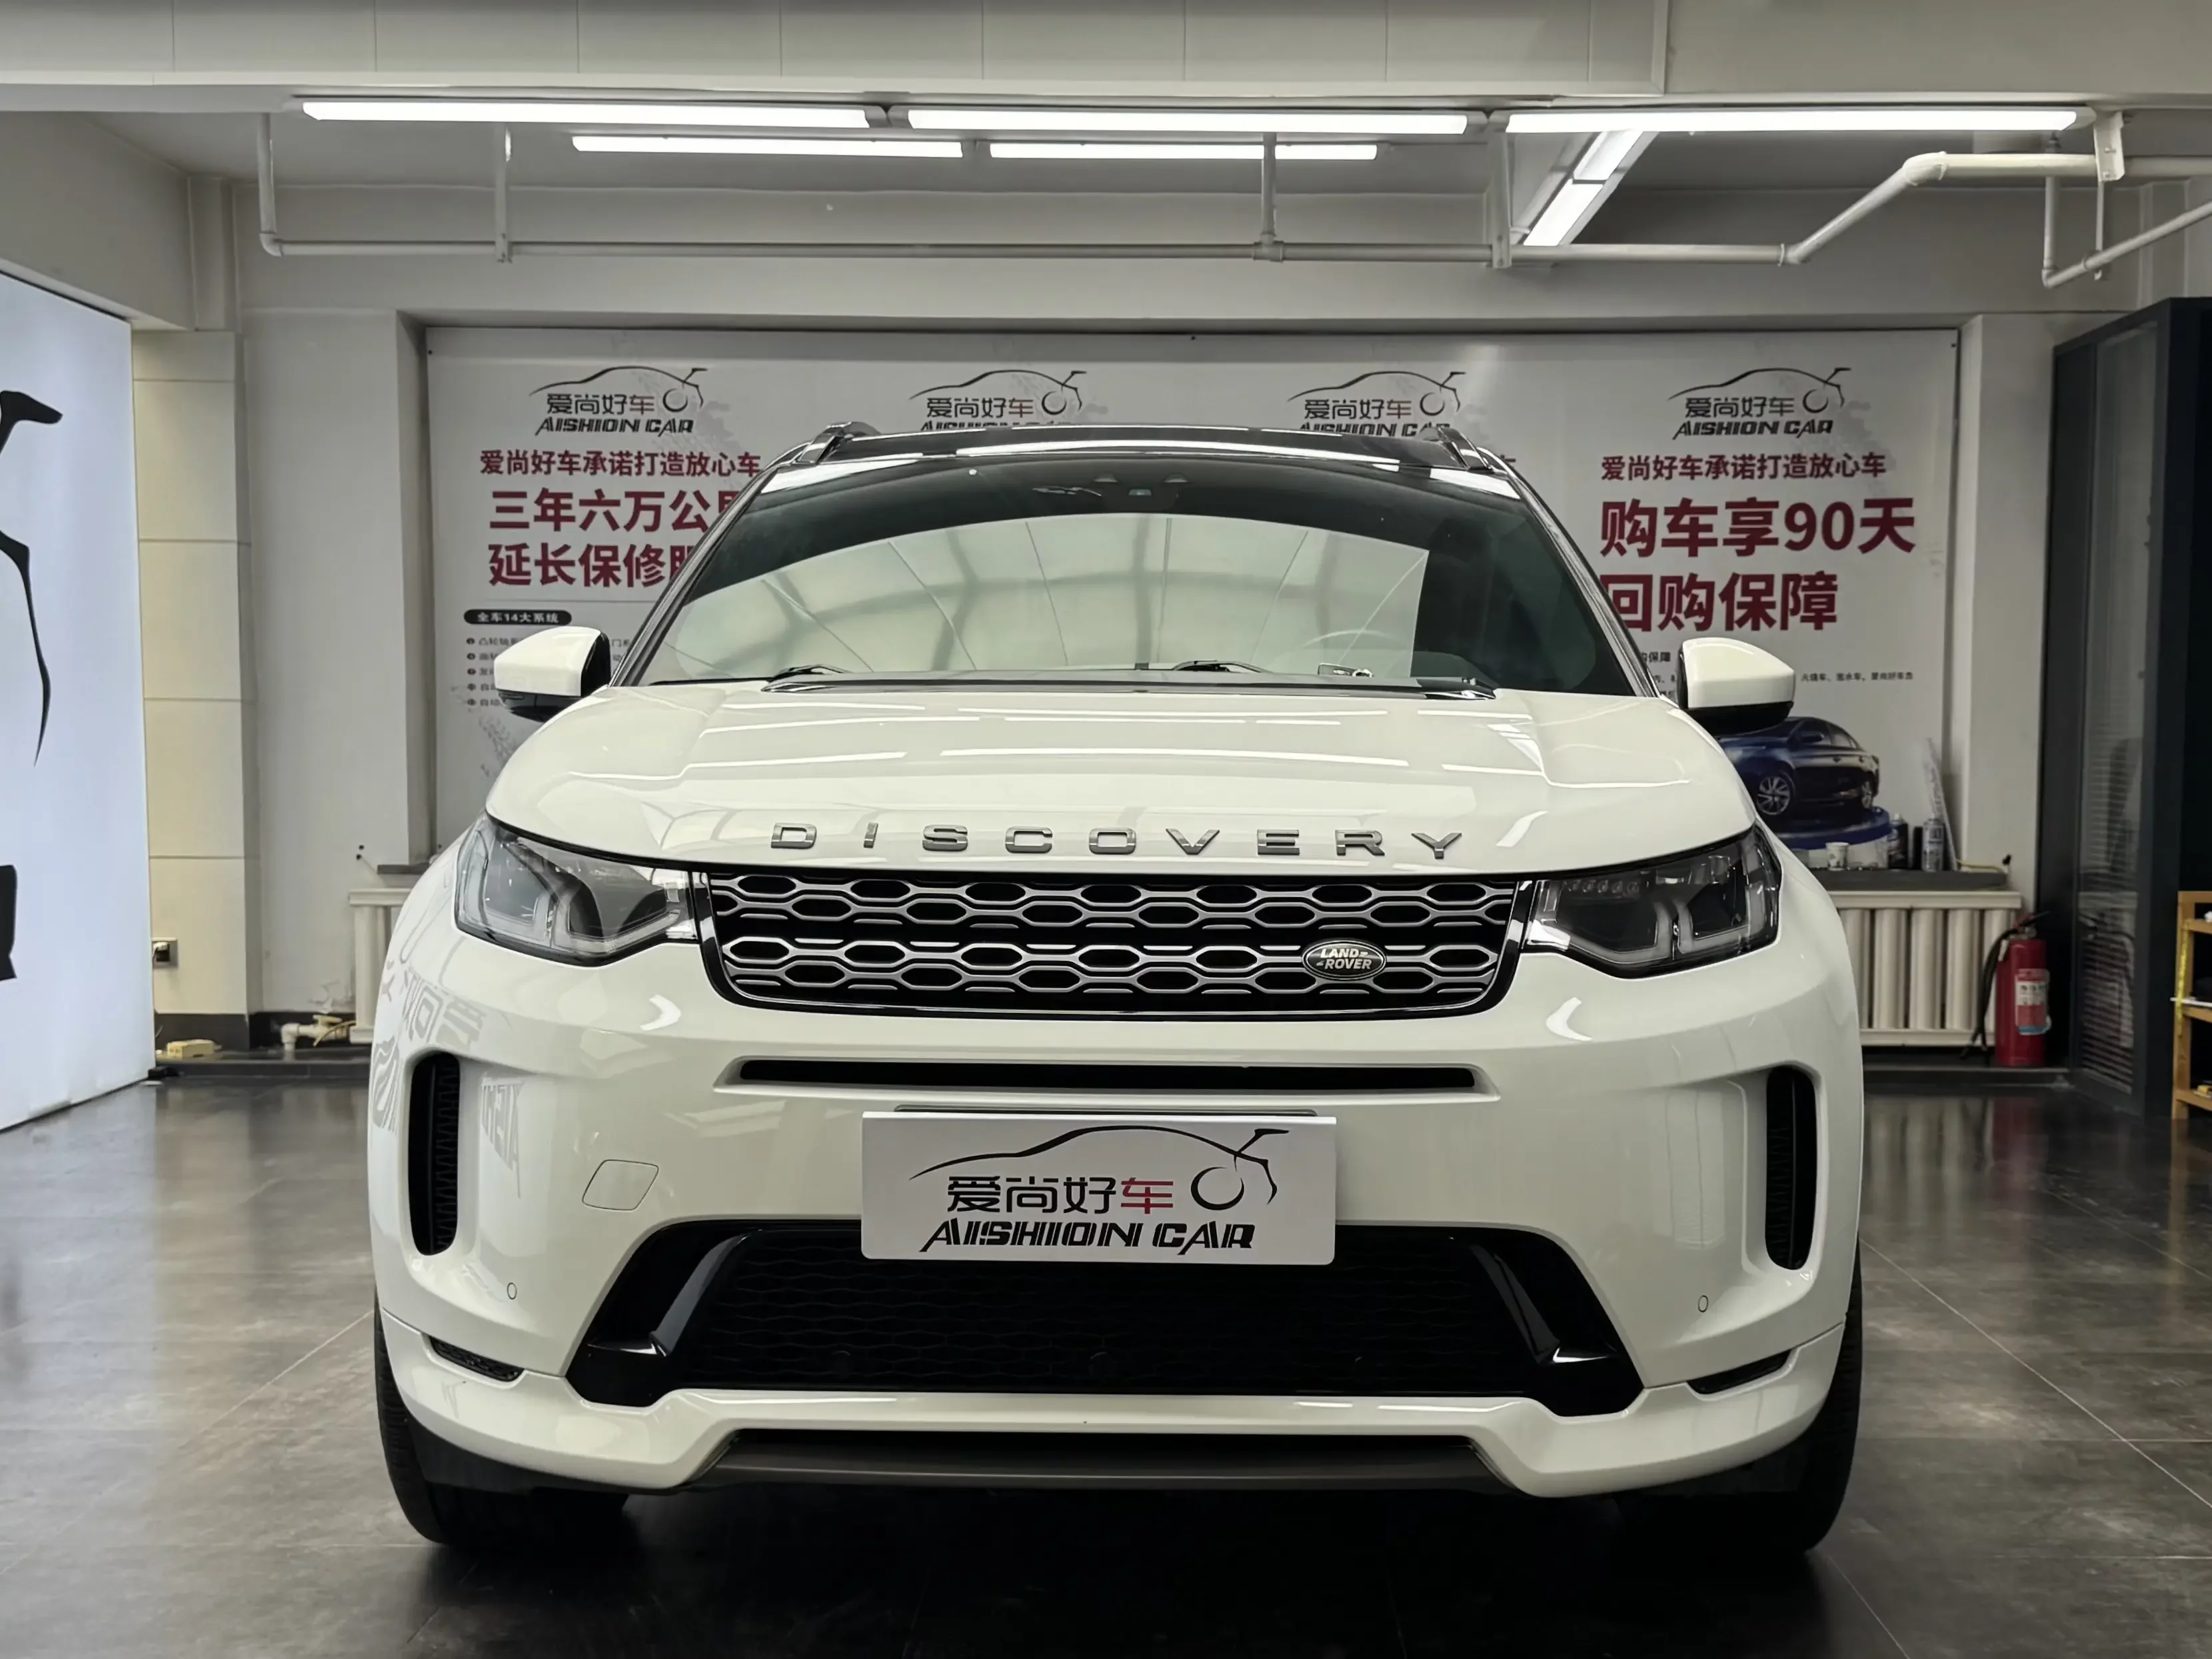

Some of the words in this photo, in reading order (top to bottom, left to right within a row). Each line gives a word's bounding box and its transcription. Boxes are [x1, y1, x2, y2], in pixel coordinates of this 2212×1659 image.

[547, 393, 655, 415] 爱尚好车
[926, 397, 1034, 419] 爱尚好车
[1304, 399, 1412, 419] 爱尚好车
[1685, 396, 1795, 418] 爱尚好车
[535, 417, 641, 437] AISHION
[645, 417, 694, 437] CAR
[1671, 420, 1779, 441] AISHION
[1783, 419, 1834, 439] CAR
[480, 449, 762, 478] 爱尚好车承诺打造放心车
[1600, 453, 1887, 481] 爱尚好车承诺打造放心车
[1600, 497, 1916, 558] 购车享90天
[1600, 571, 1838, 632] 回购保障
[770, 822, 1463, 860] DISCOVERY
[1320, 948, 1360, 958] LAND
[1324, 958, 1372, 970] ROVER
[947, 1175, 1174, 1215] 爱尚好车
[918, 1217, 1142, 1253] AISHION
[1151, 1219, 1256, 1256] CAR
